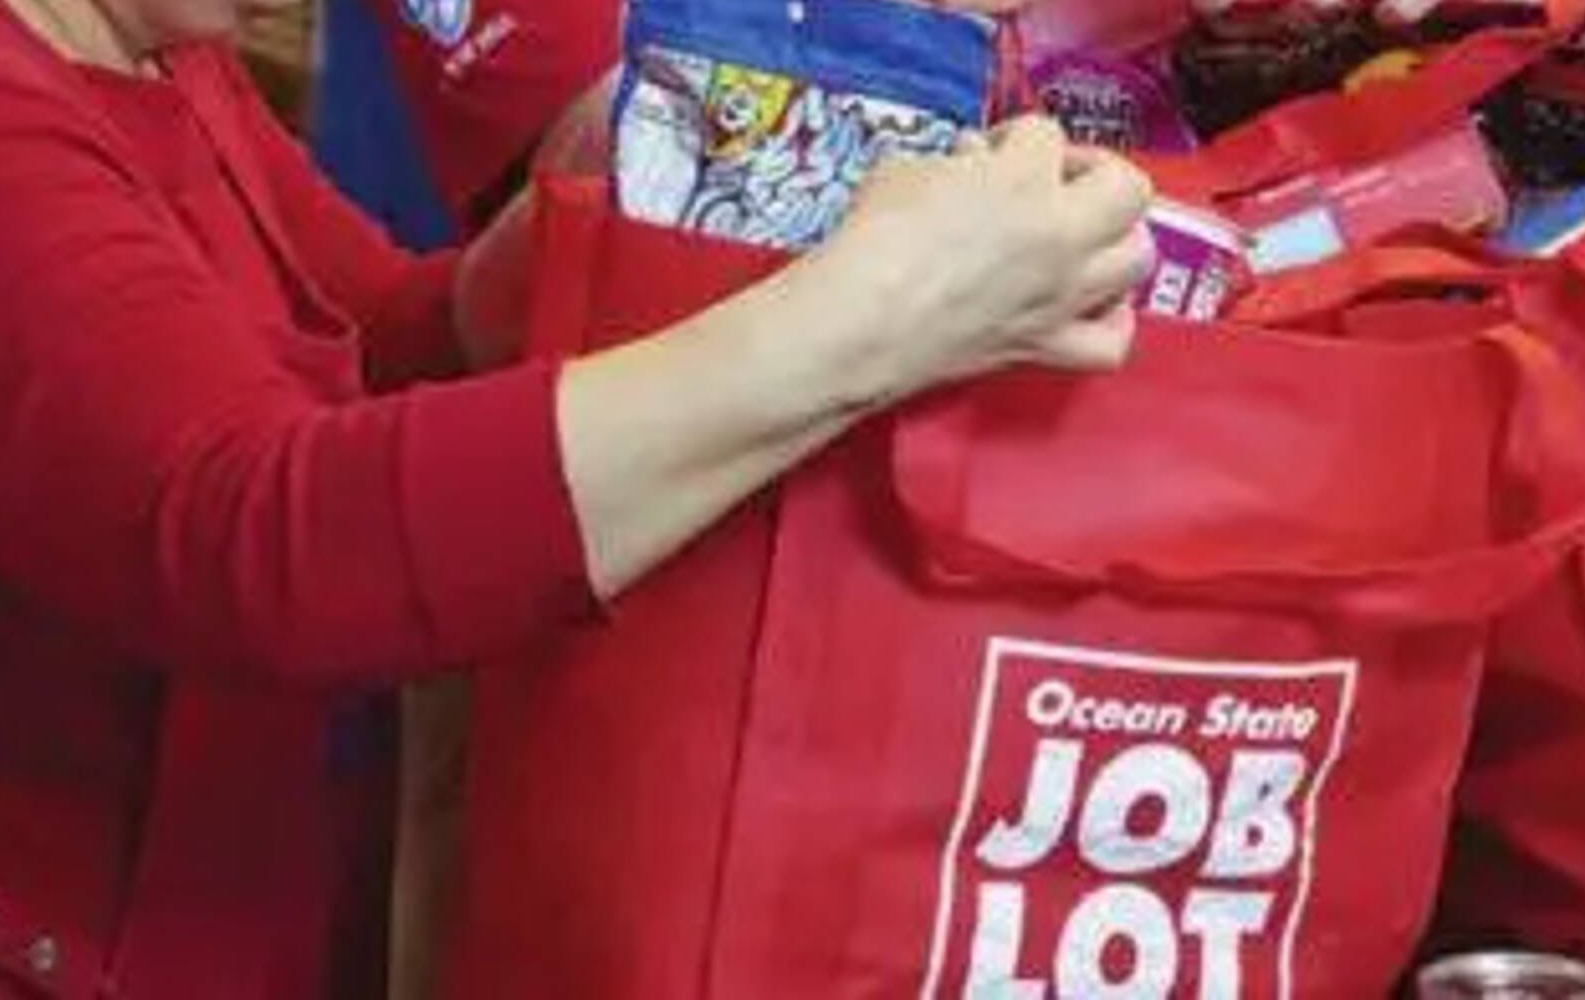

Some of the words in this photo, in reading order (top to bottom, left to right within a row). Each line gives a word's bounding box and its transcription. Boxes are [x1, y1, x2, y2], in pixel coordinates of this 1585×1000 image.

[1025, 679, 1188, 738] Ocean
[1198, 695, 1318, 740] State
[975, 740, 1306, 878] JOB
[962, 882, 1277, 1000] LOT
